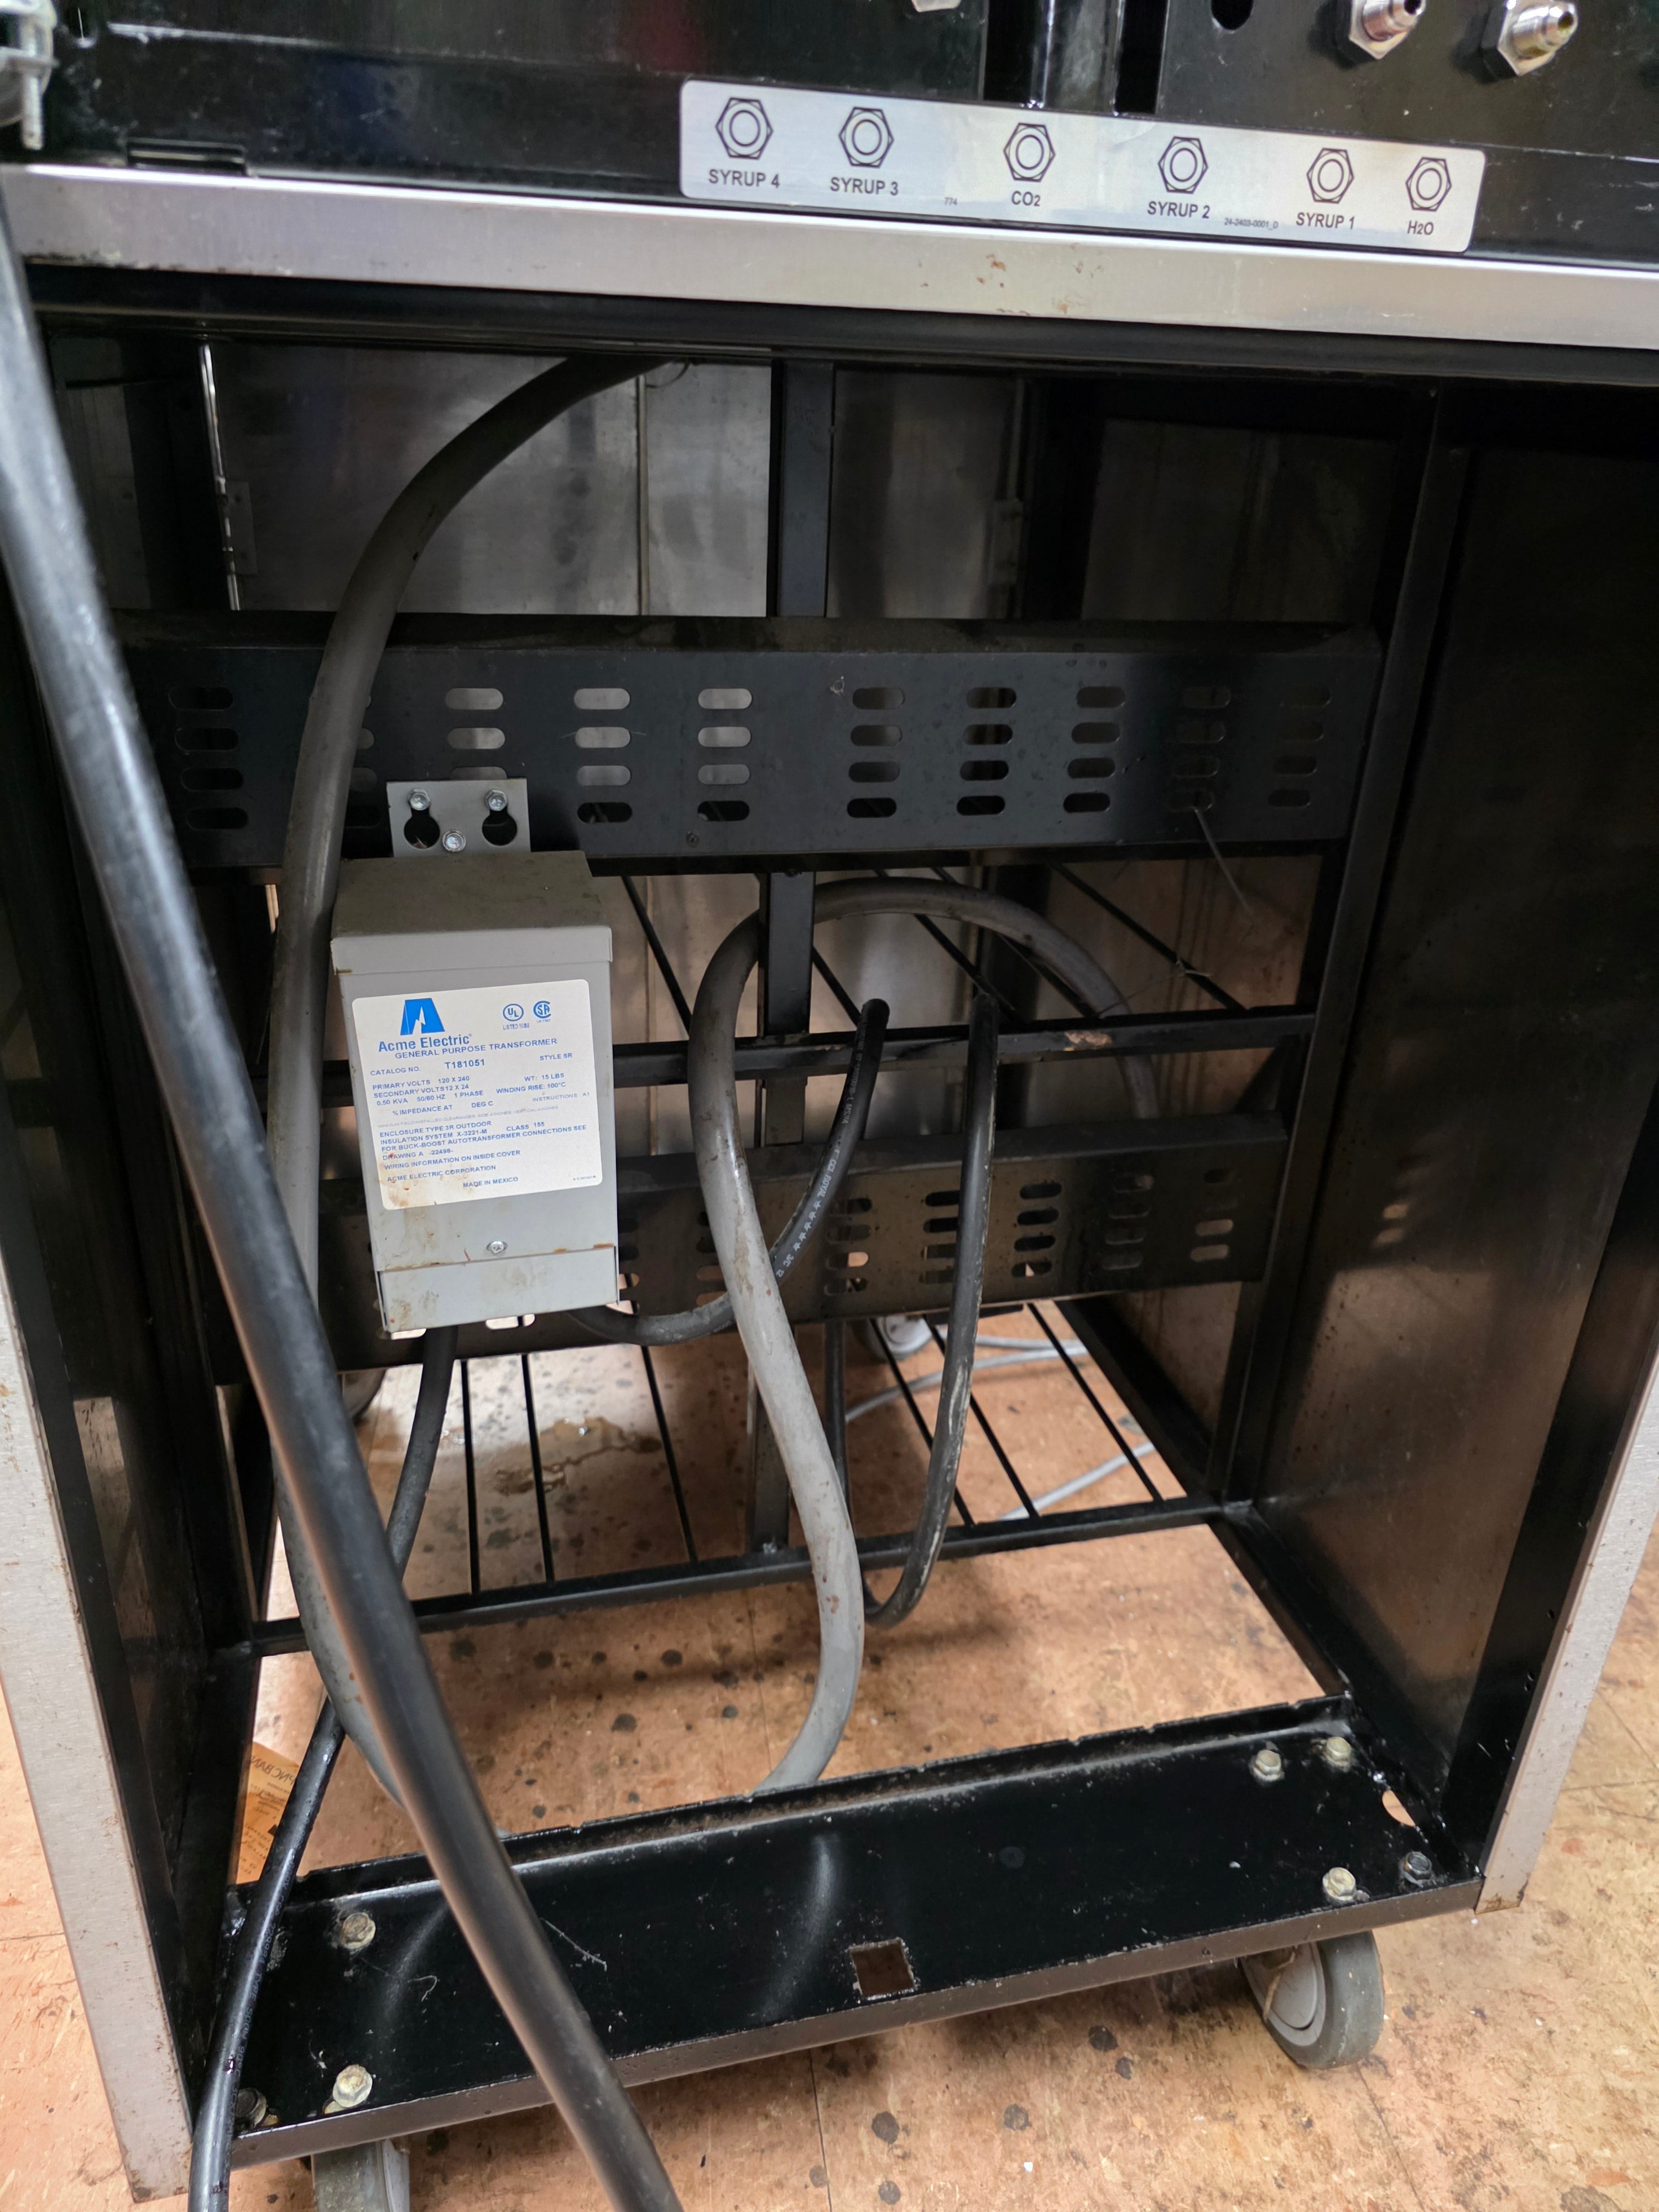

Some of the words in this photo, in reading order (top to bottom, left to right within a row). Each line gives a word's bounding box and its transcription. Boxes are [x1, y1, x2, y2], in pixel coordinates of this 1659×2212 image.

[708, 169, 766, 187] SYRUP
[771, 173, 780, 188] 4
[831, 177, 886, 195] SYRUP
[890, 181, 899, 196] 3
[1011, 191, 1040, 207] CO2
[1148, 201, 1198, 218] SYRUP
[1202, 204, 1210, 219] 2
[1297, 212, 1344, 228] SYRUP
[1349, 216, 1354, 229] 1
[1408, 221, 1433, 235] H2O
[379, 1040, 416, 1052] Acme
[395, 1050, 439, 1058] GENERAL
[442, 1045, 486, 1054] PURPOSE
[489, 1038, 557, 1050] TRANSFORMER
[445, 1059, 484, 1070] T181051
[374, 1089, 419, 1098] SECONDARY
[533, 1093, 577, 1102] INSTRUCTIONS
[400, 1106, 441, 1115] IMPEDANCE
[380, 1129, 424, 1137] ENCLOSURE
[399, 1140, 446, 1150] BUCK-BOOST
[448, 1133, 521, 1144] AUTOTRANSFORMER
[523, 1127, 572, 1136] CONNECTIONS
[381, 1136, 423, 1145] INSULATION
[383, 1152, 416, 1160] DRAWING
[384, 1161, 409, 1170] WIRING
[411, 1155, 460, 1167] INFORMATION
[410, 1171, 444, 1179] ELECTRIC
[445, 1165, 496, 1175] CORPORATION
[827, 1160, 837, 1173] CCI
[817, 1176, 832, 1198] ROYAL
[249, 1972, 263, 2001] TYPE
